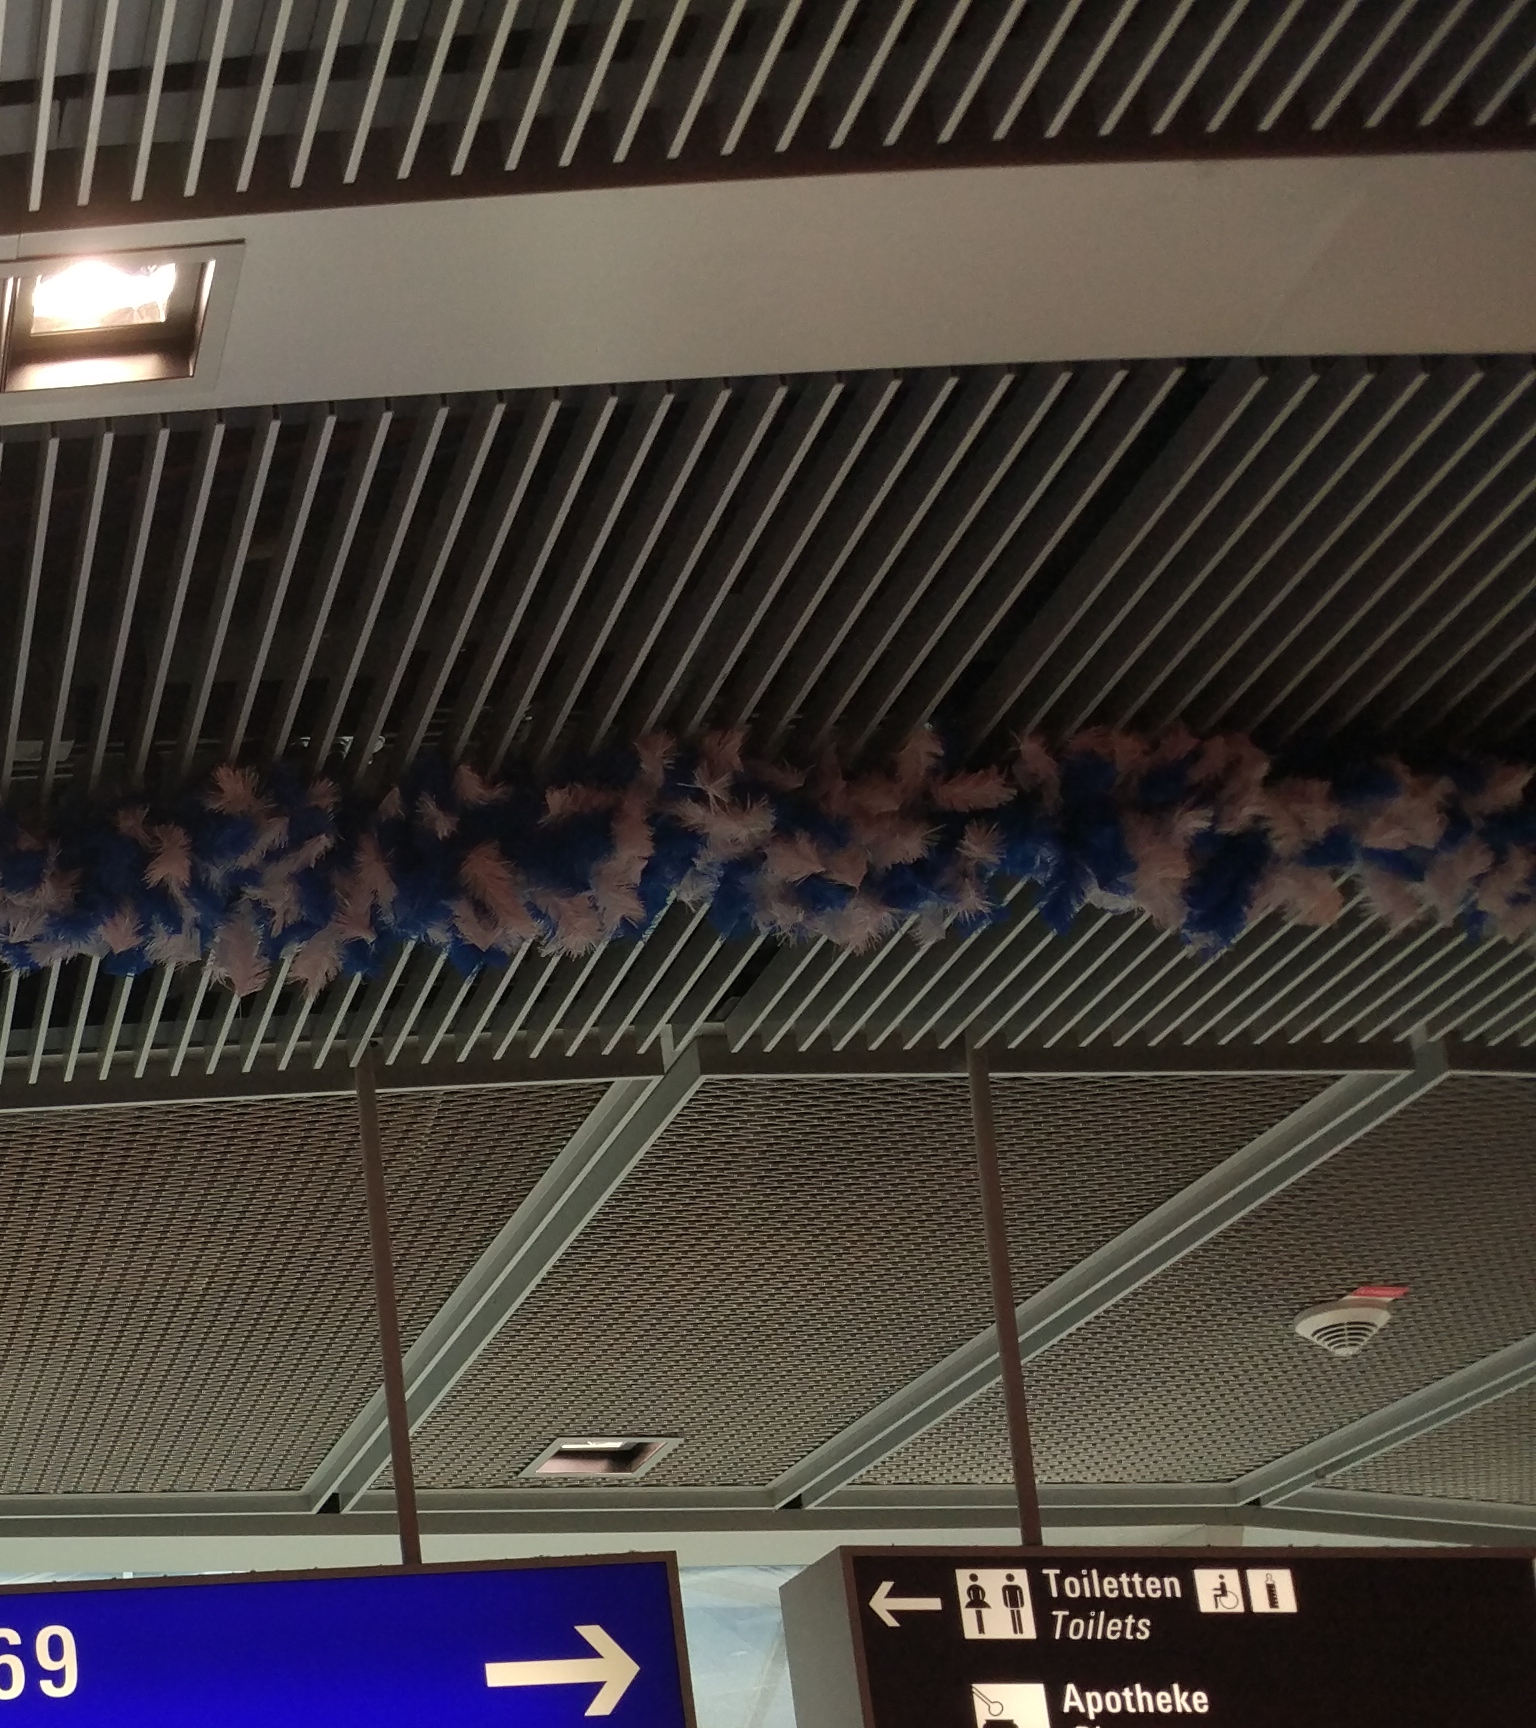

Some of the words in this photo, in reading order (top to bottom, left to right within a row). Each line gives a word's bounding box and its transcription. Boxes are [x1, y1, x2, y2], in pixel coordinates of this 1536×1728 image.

[1041, 1567, 1182, 1599] Toiletten
[1051, 1610, 1151, 1641] Toilets
[1062, 1683, 1210, 1719] Apotheke
